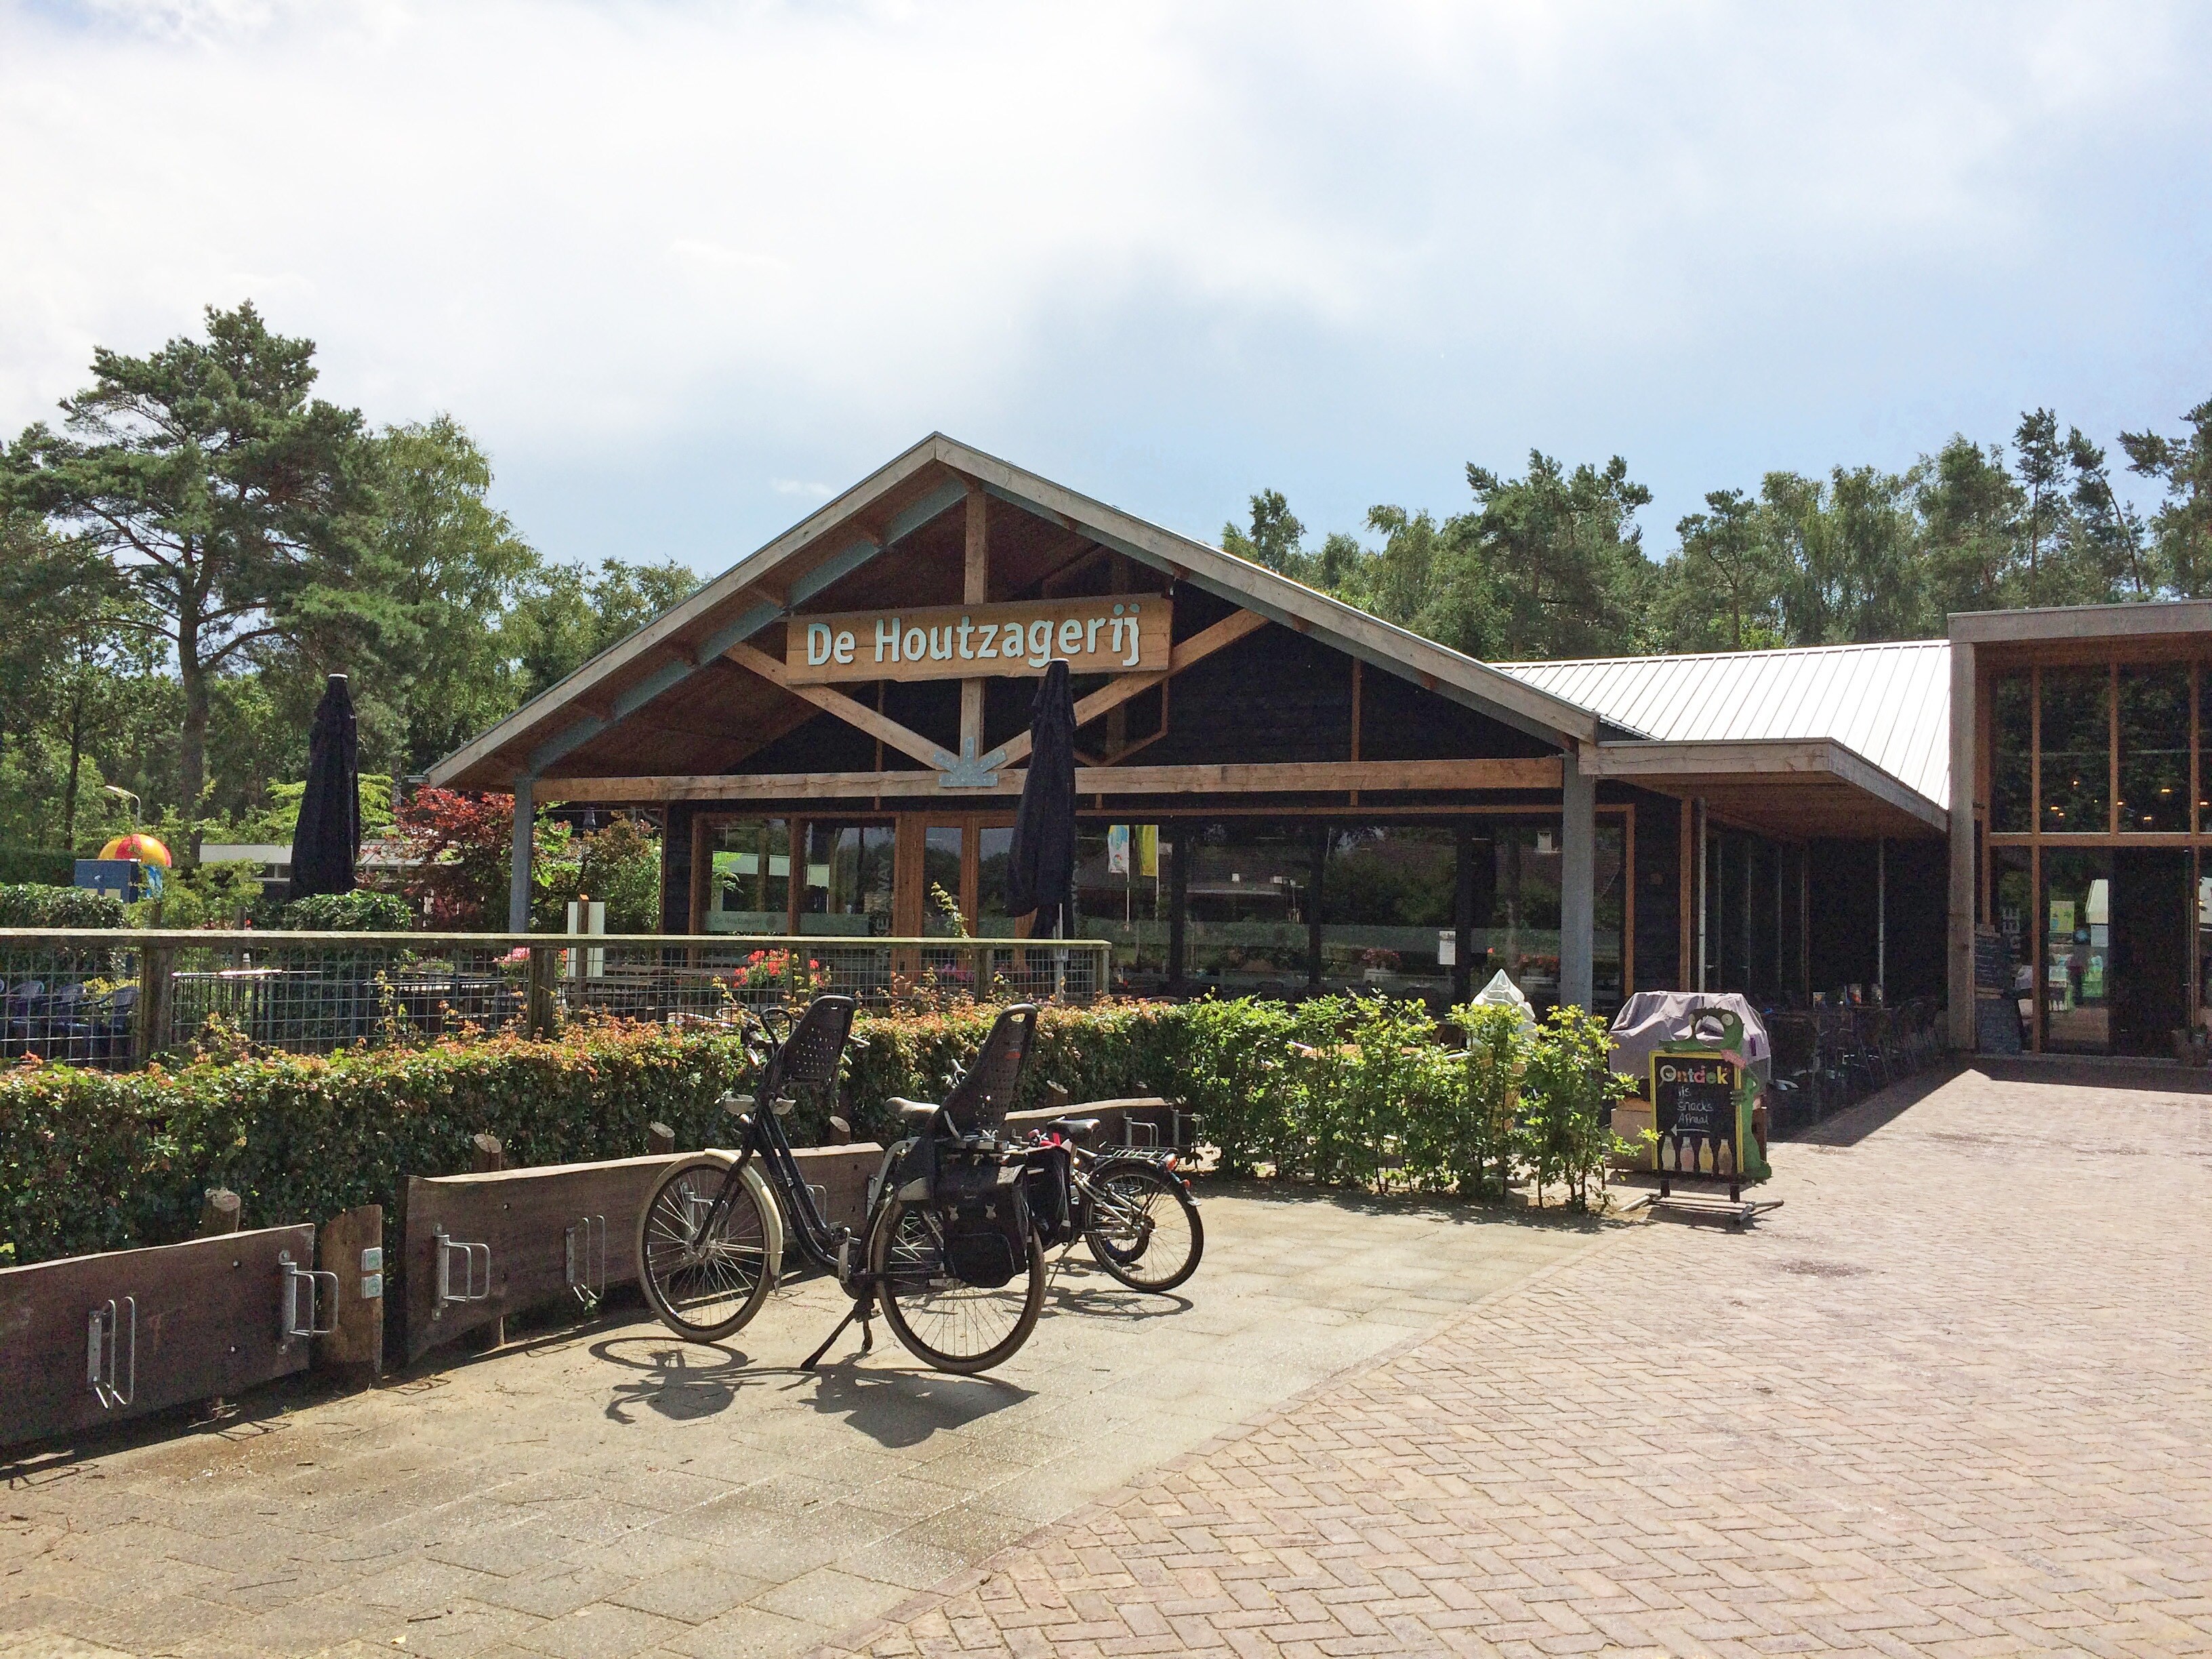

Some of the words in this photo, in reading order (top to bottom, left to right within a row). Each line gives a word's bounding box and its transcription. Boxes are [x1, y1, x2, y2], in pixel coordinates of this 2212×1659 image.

[808, 623, 855, 665] De
[875, 603, 1141, 668] Houtzagerij
[1660, 1065, 1728, 1084] Ontdek
